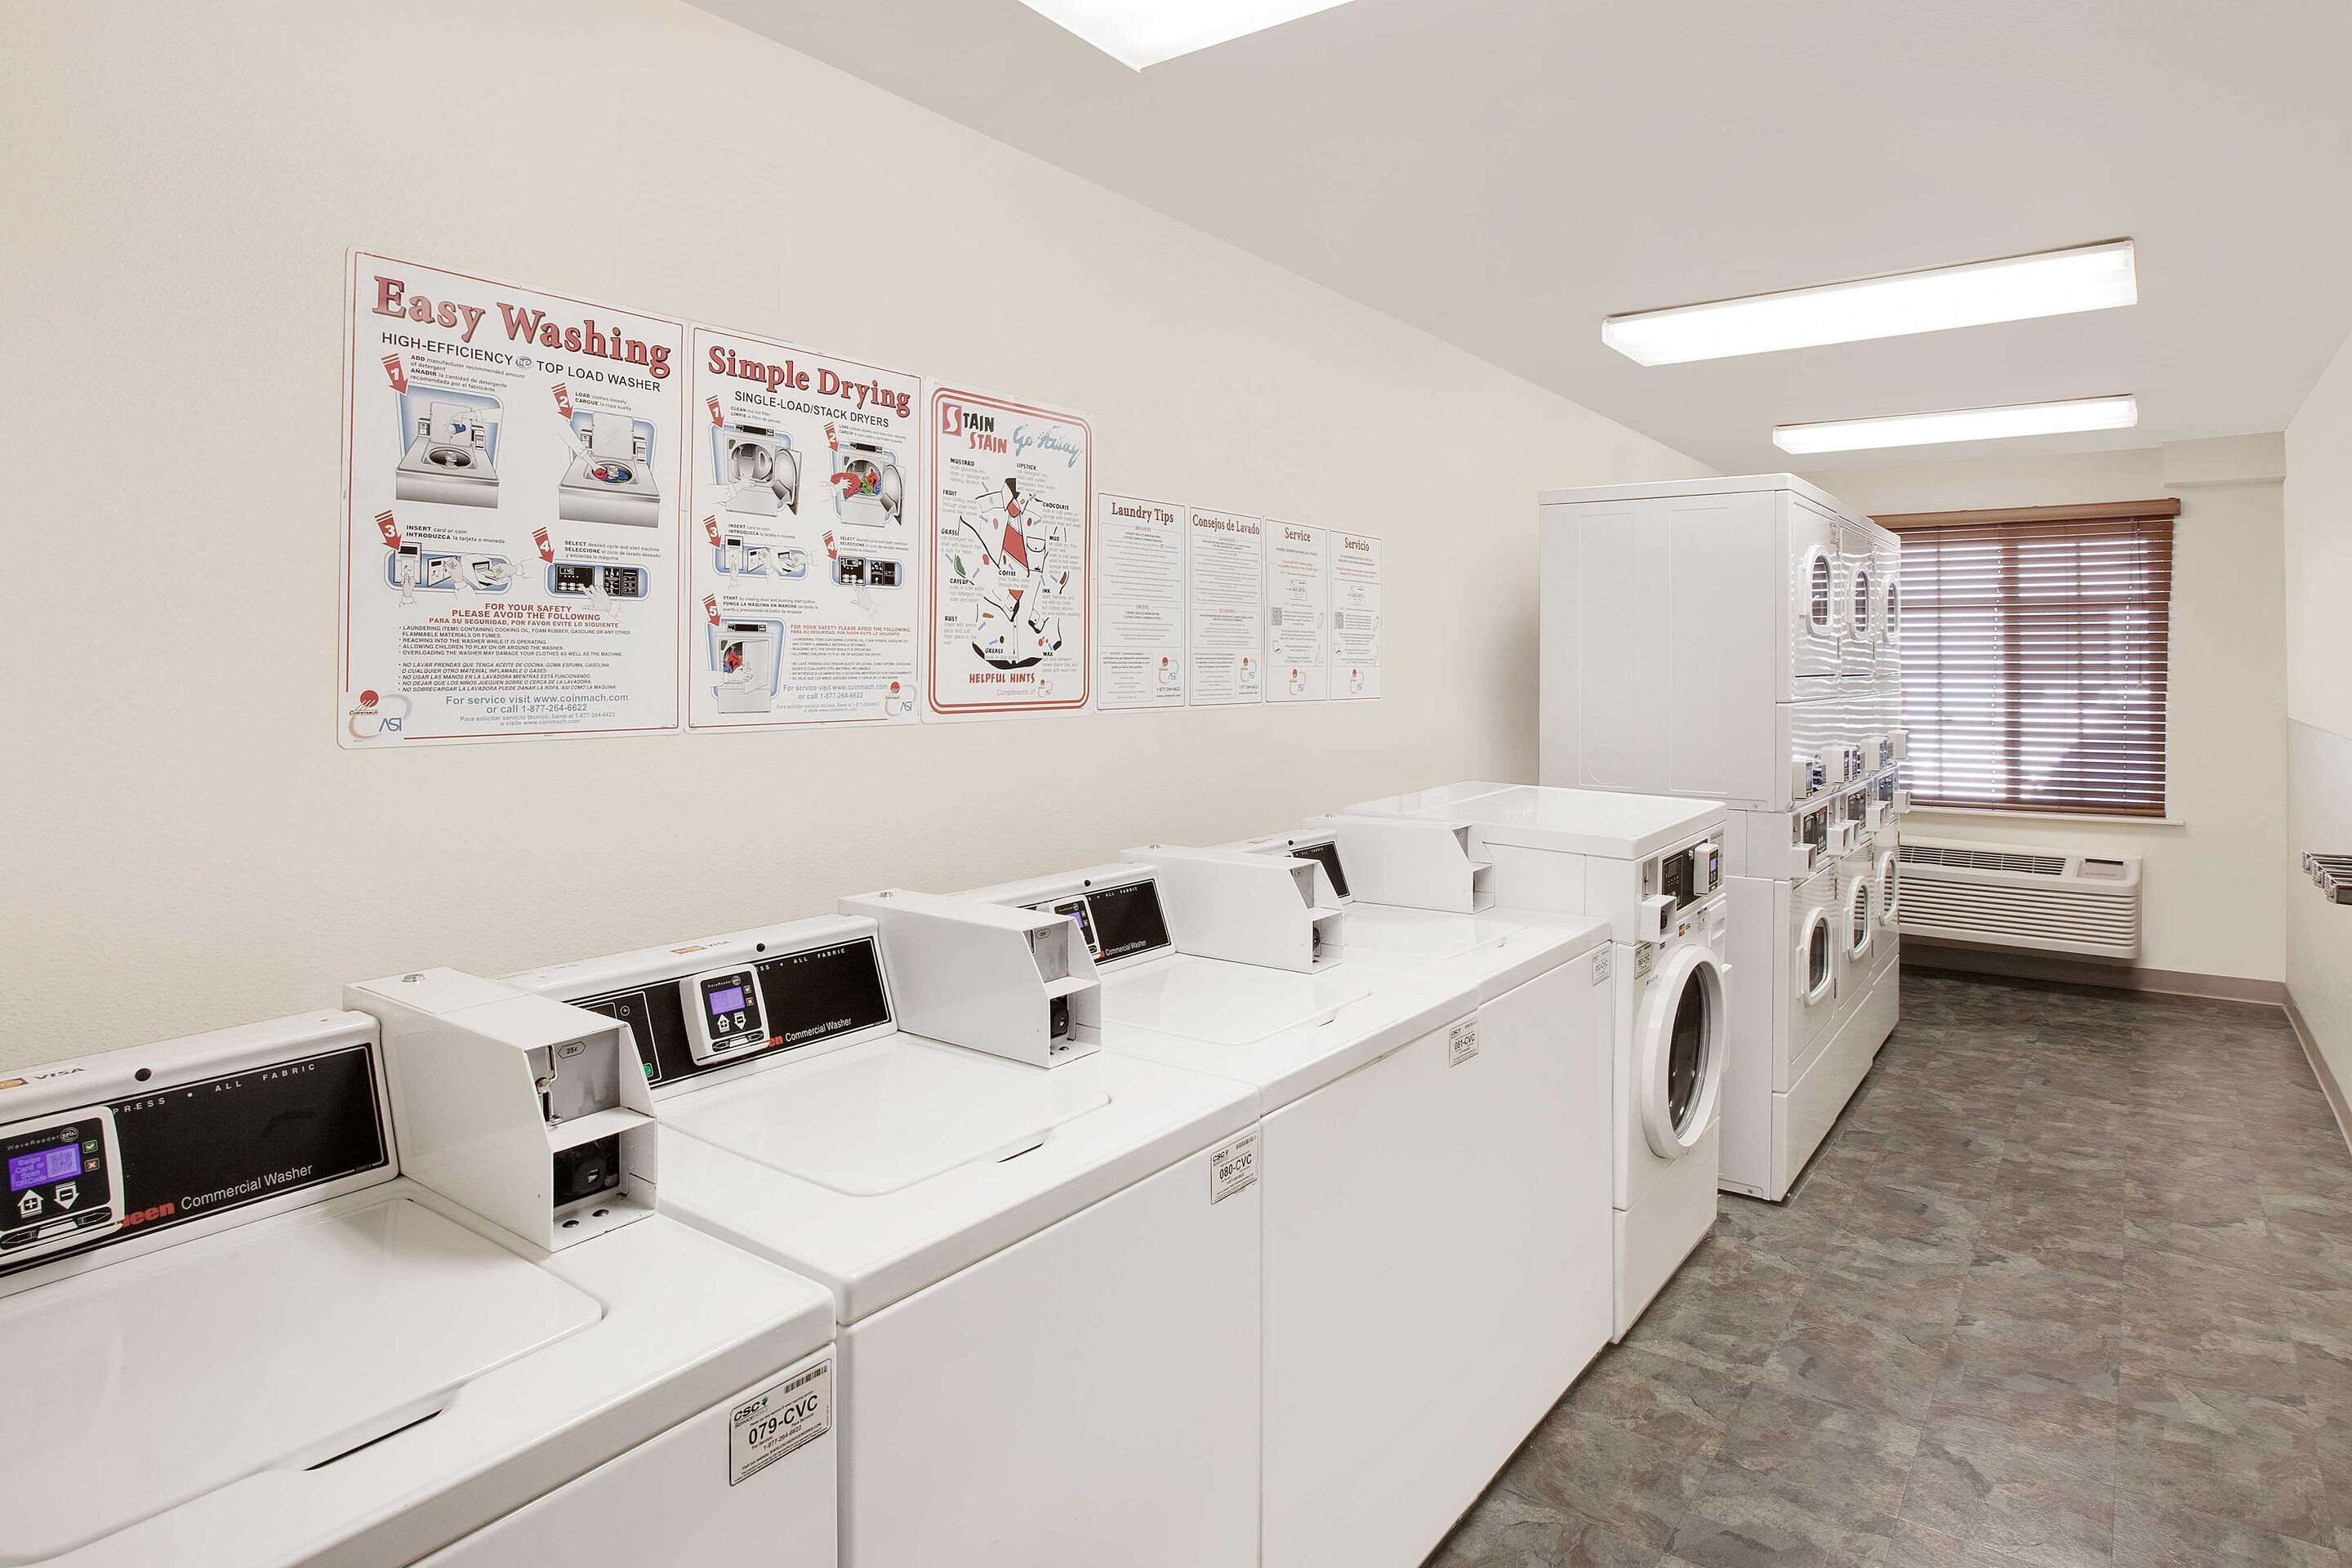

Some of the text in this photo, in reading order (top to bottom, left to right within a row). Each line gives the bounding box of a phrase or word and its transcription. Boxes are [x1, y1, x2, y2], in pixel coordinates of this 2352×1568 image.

[372, 276, 670, 378] Easy Washing
[382, 332, 513, 364] HIGH-EFFICIENCY
[410, 368, 437, 376] AÑADIR
[417, 362, 446, 372] detergent
[426, 358, 465, 368] manufacturer
[466, 365, 504, 375] recommended
[390, 367, 399, 381] 1
[536, 360, 660, 392] TOP LOAD WASHER
[708, 346, 809, 393] Simple
[817, 368, 911, 417] Drying
[559, 395, 568, 408] 2
[712, 406, 719, 417] 1
[734, 390, 847, 420] SINGLE-LOAD/STACK
[850, 412, 889, 427] DRYERS
[943, 405, 995, 434] STAIN
[828, 431, 835, 443] 2
[969, 432, 1007, 454] STAIN
[1013, 424, 1081, 468] Go Away
[950, 458, 975, 466] MUSTARD
[1043, 501, 1070, 510] CHOCOLATE
[1111, 502, 1174, 526] Laundry Tips
[385, 524, 395, 537] 3
[1192, 514, 1260, 535] Consejos de Lavado
[406, 532, 451, 540] INTRODUZCA
[709, 527, 716, 537] 3
[1284, 527, 1311, 542] Service
[540, 540, 550, 552] 4
[828, 541, 835, 550] 4
[1344, 537, 1370, 551] Servicio
[484, 603, 572, 612] FOR YOUR SAFETY
[709, 606, 716, 616] 5
[452, 609, 490, 617] PLEASE
[492, 610, 523, 619] AVOID
[547, 612, 600, 621] FOLLOWING
[969, 673, 1036, 684] HELPFUL HINTS
[795, 684, 817, 693] service
[831, 683, 888, 691] www.coinmach.com
[445, 693, 628, 705] For service visit www.coinmach.com
[500, 704, 519, 714] call
[521, 703, 587, 712] 1-877-264-6622
[1120, 886, 1138, 894] FABRIC
[817, 948, 846, 959] FABRIC
[1105, 939, 1147, 956] Commercial Washer
[786, 1024, 826, 1043] Commercial
[826, 1018, 853, 1034] Washer
[33, 1067, 85, 1080] VISA
[113, 1063, 316, 1116] PRESS ALL FABRIC
[7, 1135, 60, 1151] WaveReader
[1213, 1152, 1225, 1162] CSC
[1219, 1154, 1252, 1179] 080-CVC
[181, 1177, 262, 1211] Commercial
[265, 1164, 313, 1186] Washer
[734, 1401, 760, 1422] CSC
[748, 1395, 818, 1445] 079-CVC
[764, 1425, 802, 1450] 1-877-264-6622
